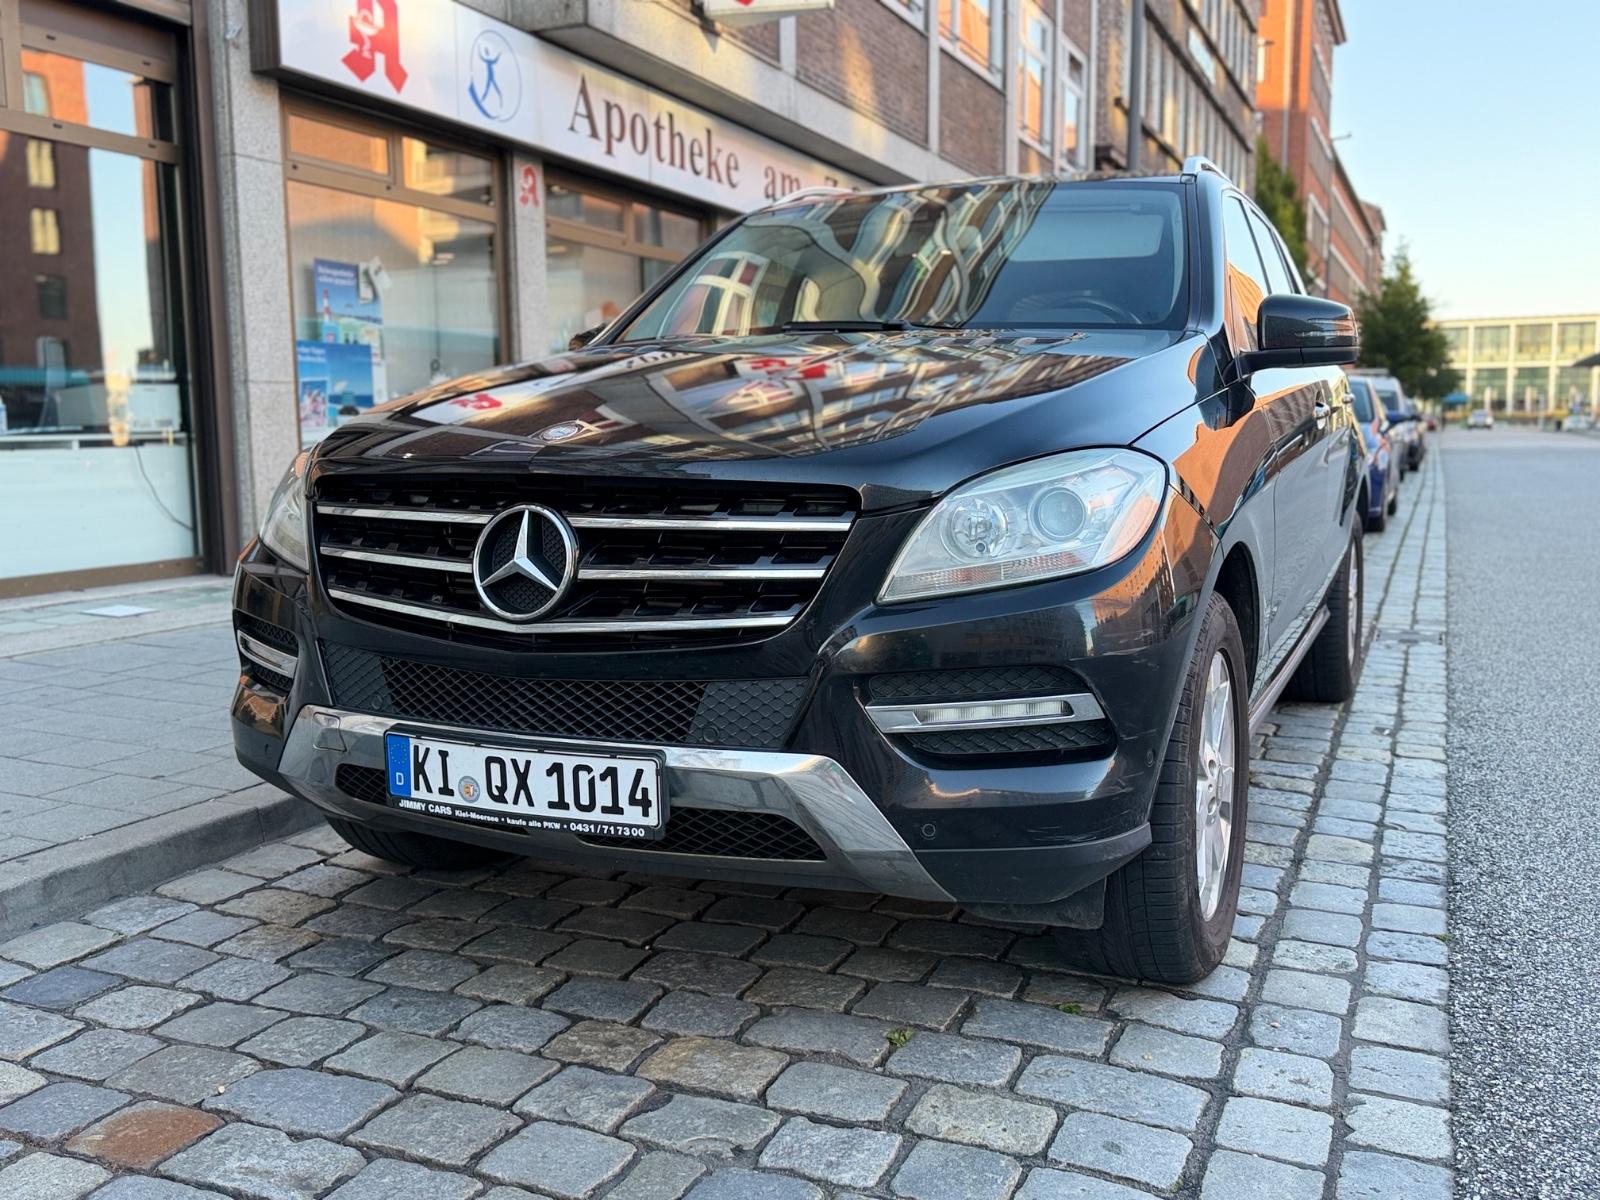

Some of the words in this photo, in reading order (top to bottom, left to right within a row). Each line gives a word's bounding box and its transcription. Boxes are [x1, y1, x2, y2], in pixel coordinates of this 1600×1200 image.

[567, 73, 741, 190] Apotheke
[764, 164, 801, 200] am
[395, 772, 404, 786] D
[413, 744, 455, 797] KI
[484, 755, 535, 807] QX
[545, 761, 652, 818] 1014
[399, 799, 426, 811] JIMMY
[428, 803, 453, 816] CARS
[528, 820, 542, 828] alle
[543, 821, 561, 830] PKW
